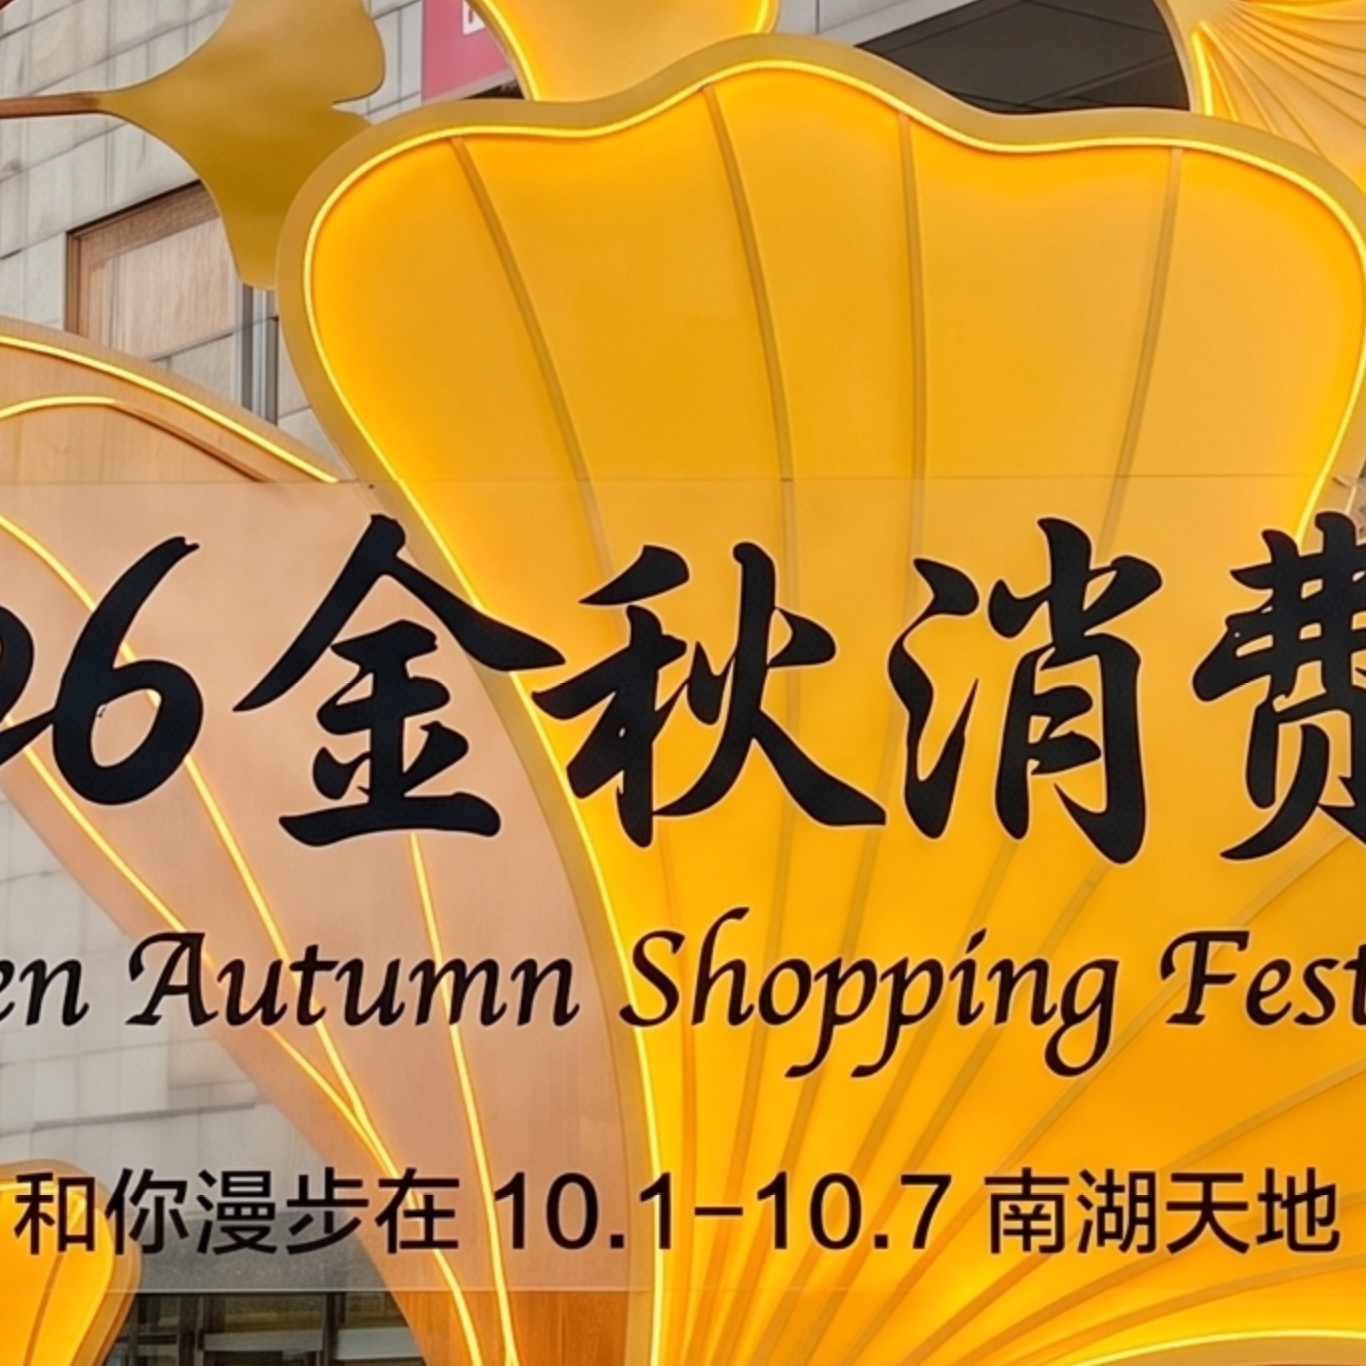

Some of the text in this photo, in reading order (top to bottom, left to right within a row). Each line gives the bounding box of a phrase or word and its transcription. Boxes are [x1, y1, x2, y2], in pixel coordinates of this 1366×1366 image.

[125, 930, 581, 1028] Autumn
[619, 907, 1119, 1078] Shopping
[14, 1166, 461, 1256] 和你漫步在
[984, 1167, 1341, 1255] 南湖天地
